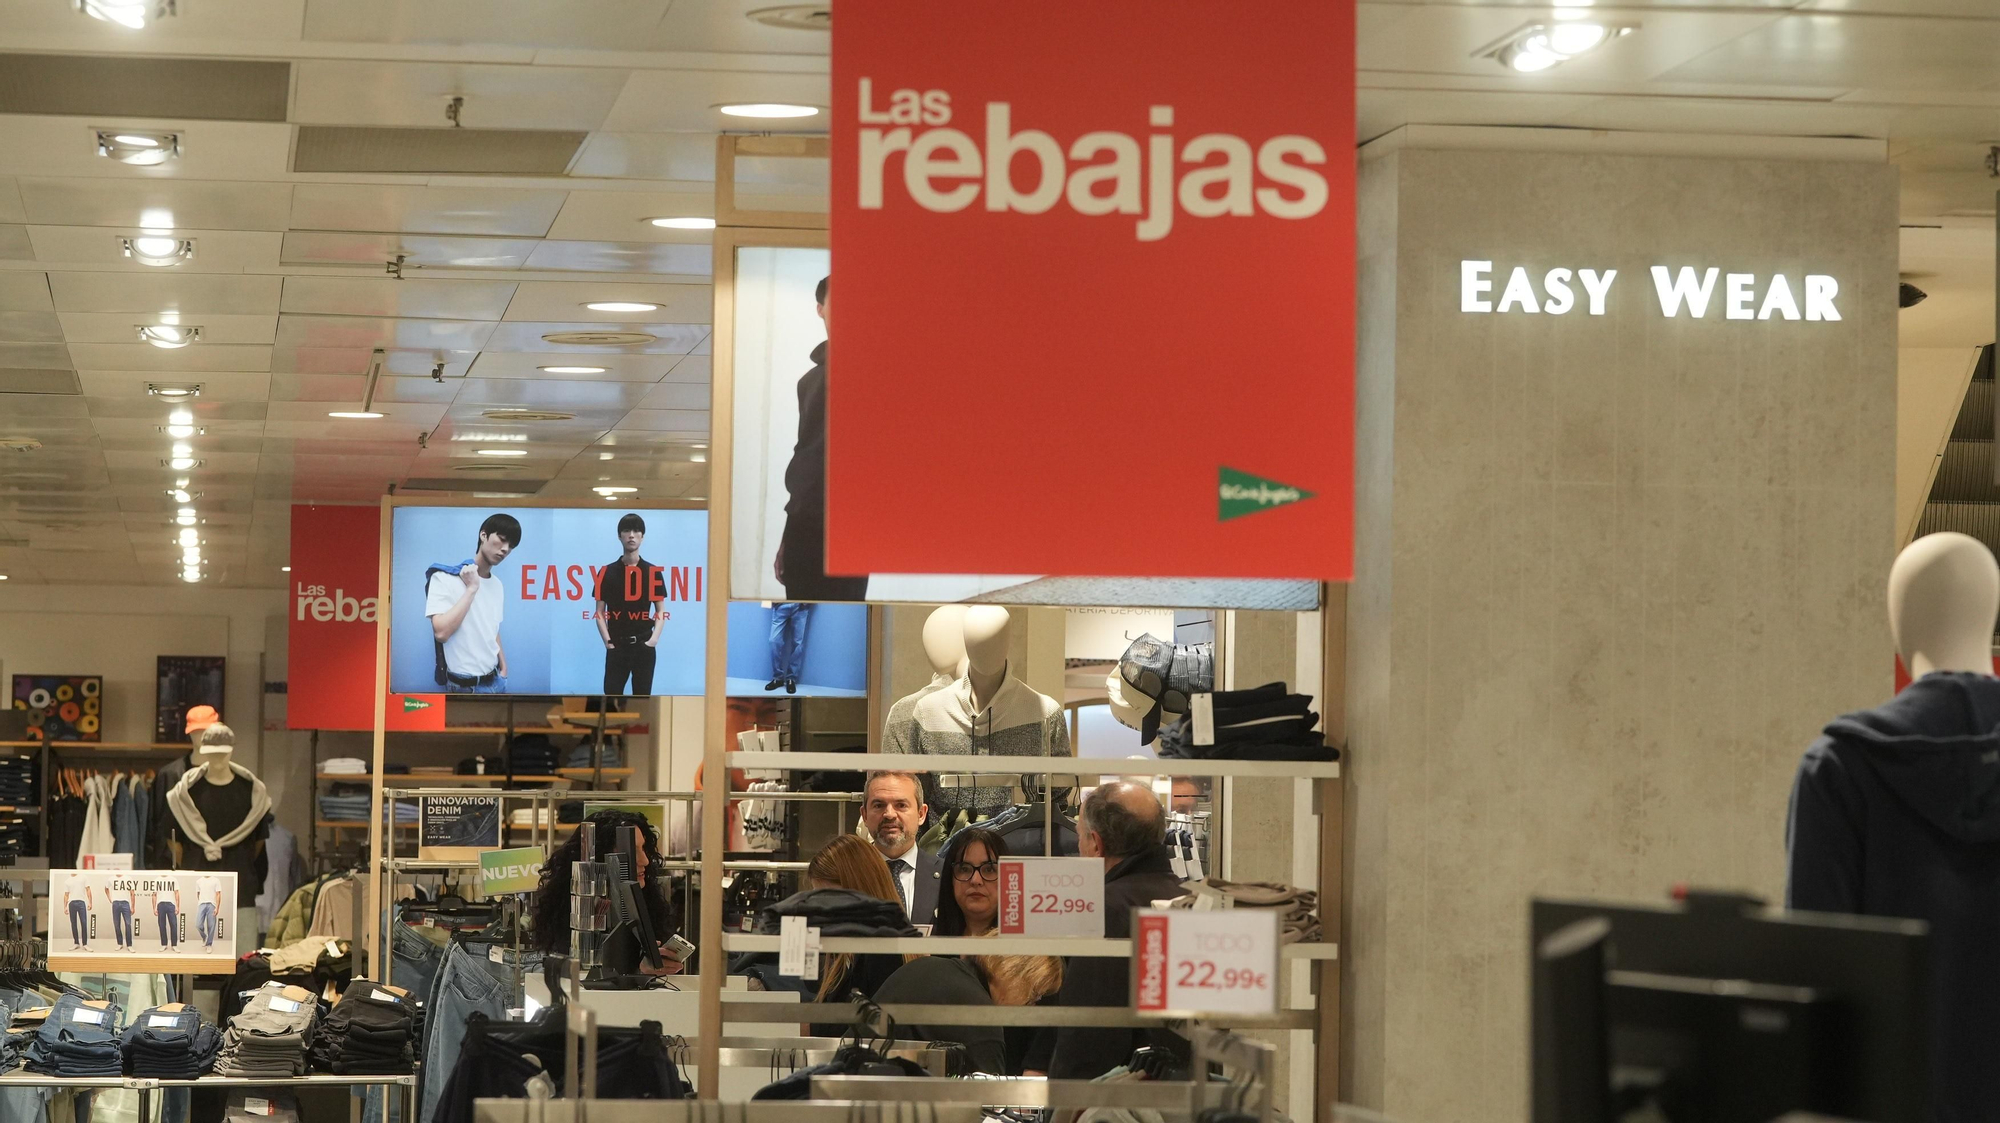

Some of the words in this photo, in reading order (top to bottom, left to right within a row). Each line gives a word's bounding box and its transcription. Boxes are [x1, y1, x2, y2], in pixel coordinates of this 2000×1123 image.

[858, 77, 952, 125] Las
[858, 102, 1329, 241] rebajas
[1461, 260, 1618, 315] EASY
[1650, 265, 1842, 321] WEAR
[297, 581, 326, 596] Las
[521, 564, 608, 601] EASY
[624, 565, 703, 602] DENI
[297, 588, 379, 622] reba
[582, 611, 622, 620] EASY
[628, 611, 671, 621] WEAR
[427, 796, 495, 805] INNOVATION
[427, 806, 461, 815] DENIM
[113, 880, 139, 891] EASY
[143, 880, 175, 892] DENIM
[1041, 874, 1085, 888] TODO
[1005, 872, 1021, 926] rebajas
[1030, 894, 1095, 915] 22,99€
[1195, 933, 1254, 953] TODO
[1177, 960, 1268, 993] 22,99€
